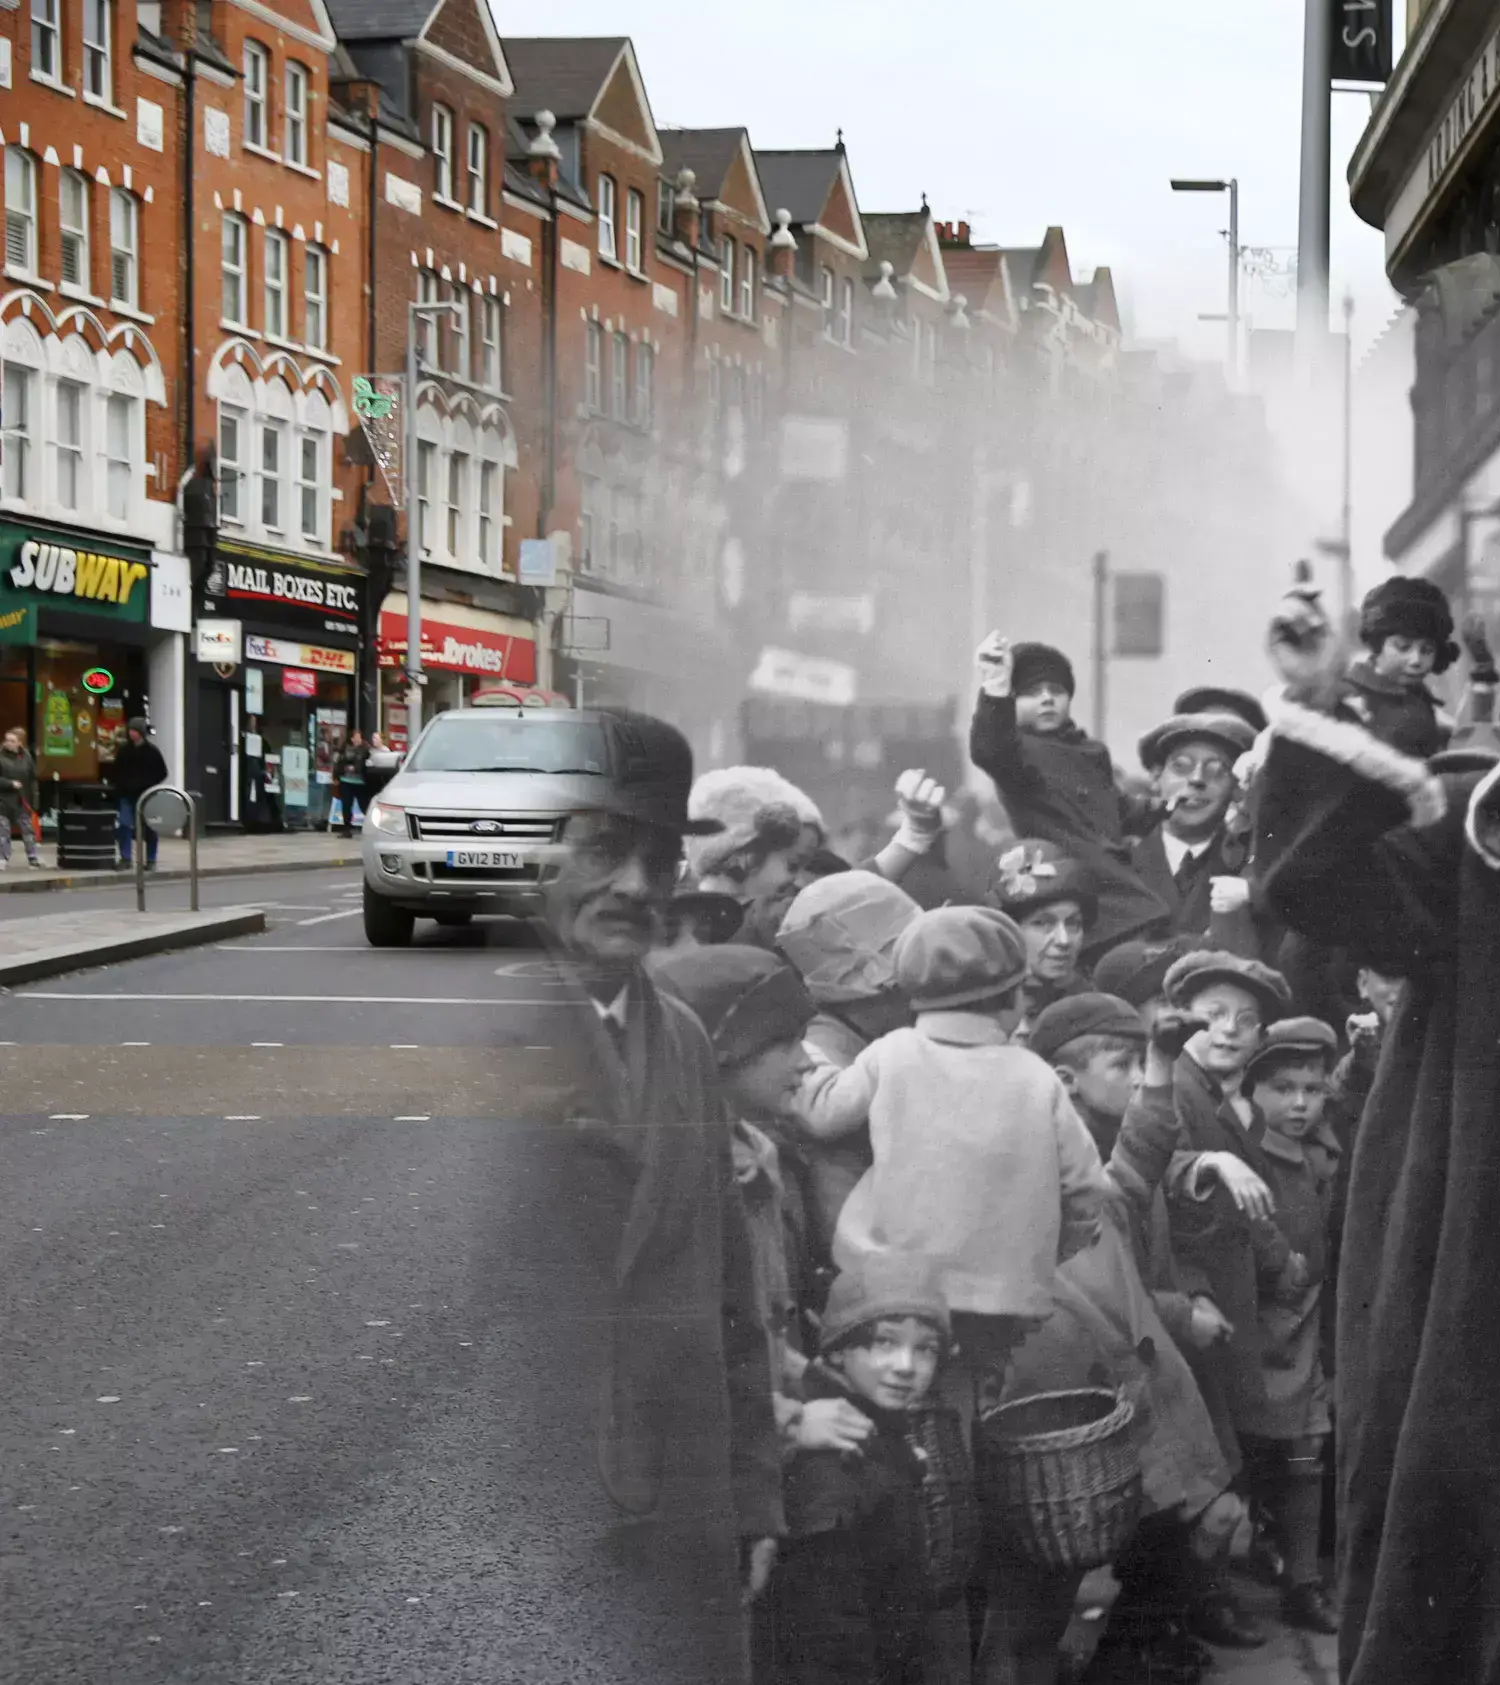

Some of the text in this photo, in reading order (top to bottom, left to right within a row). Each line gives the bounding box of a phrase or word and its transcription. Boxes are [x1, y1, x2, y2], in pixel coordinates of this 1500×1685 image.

[10, 540, 148, 605] SUBWAY
[227, 563, 359, 611] MAIL BOXES ETC.
[250, 636, 278, 658] FedEx
[458, 852, 519, 866] GV12 BTY
